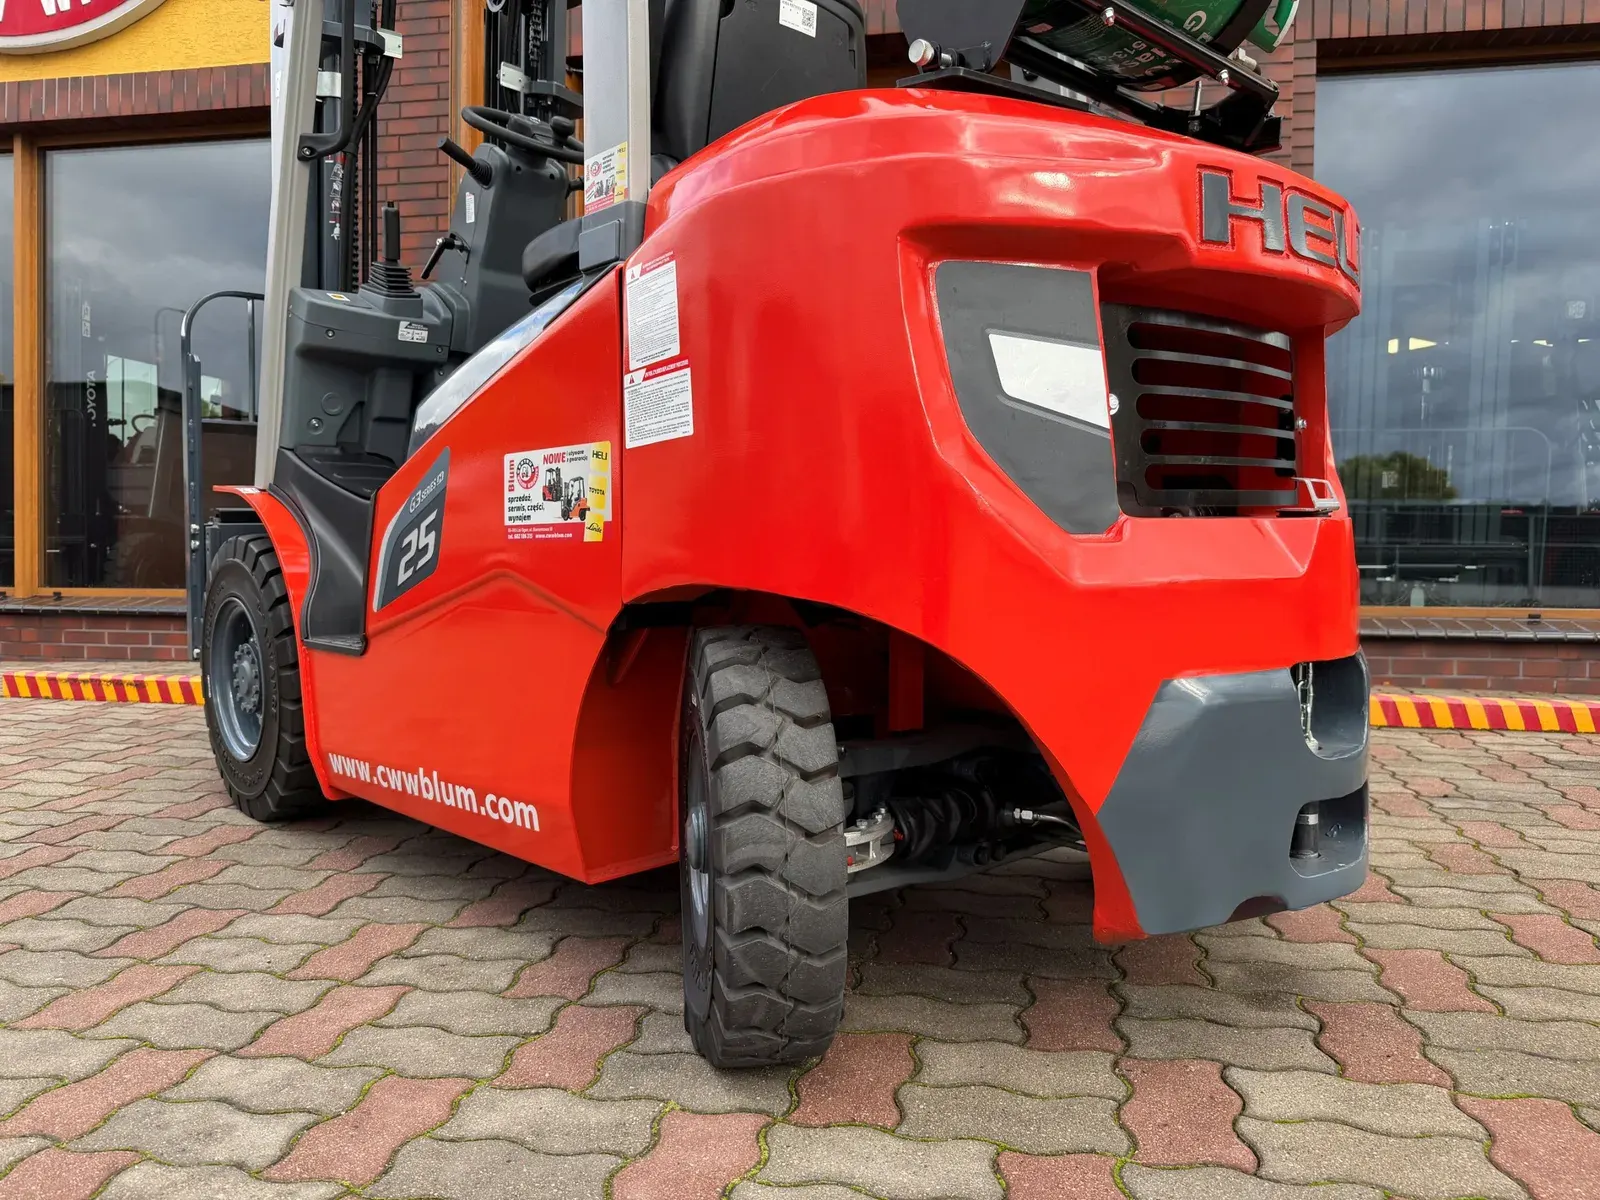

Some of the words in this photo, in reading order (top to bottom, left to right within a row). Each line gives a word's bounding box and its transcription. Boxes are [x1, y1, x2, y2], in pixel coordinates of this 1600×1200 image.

[543, 452, 566, 465] NOWE
[592, 449, 608, 461] HELI
[588, 487, 605, 496] TOYOTA
[508, 493, 532, 504] sprzedaż,
[508, 503, 527, 513] serwis,
[527, 502, 545, 512] części,
[508, 514, 531, 523] wynajem
[586, 522, 602, 534] Linde
[397, 509, 438, 587] 25
[328, 752, 540, 832] www.cwwblum.com
